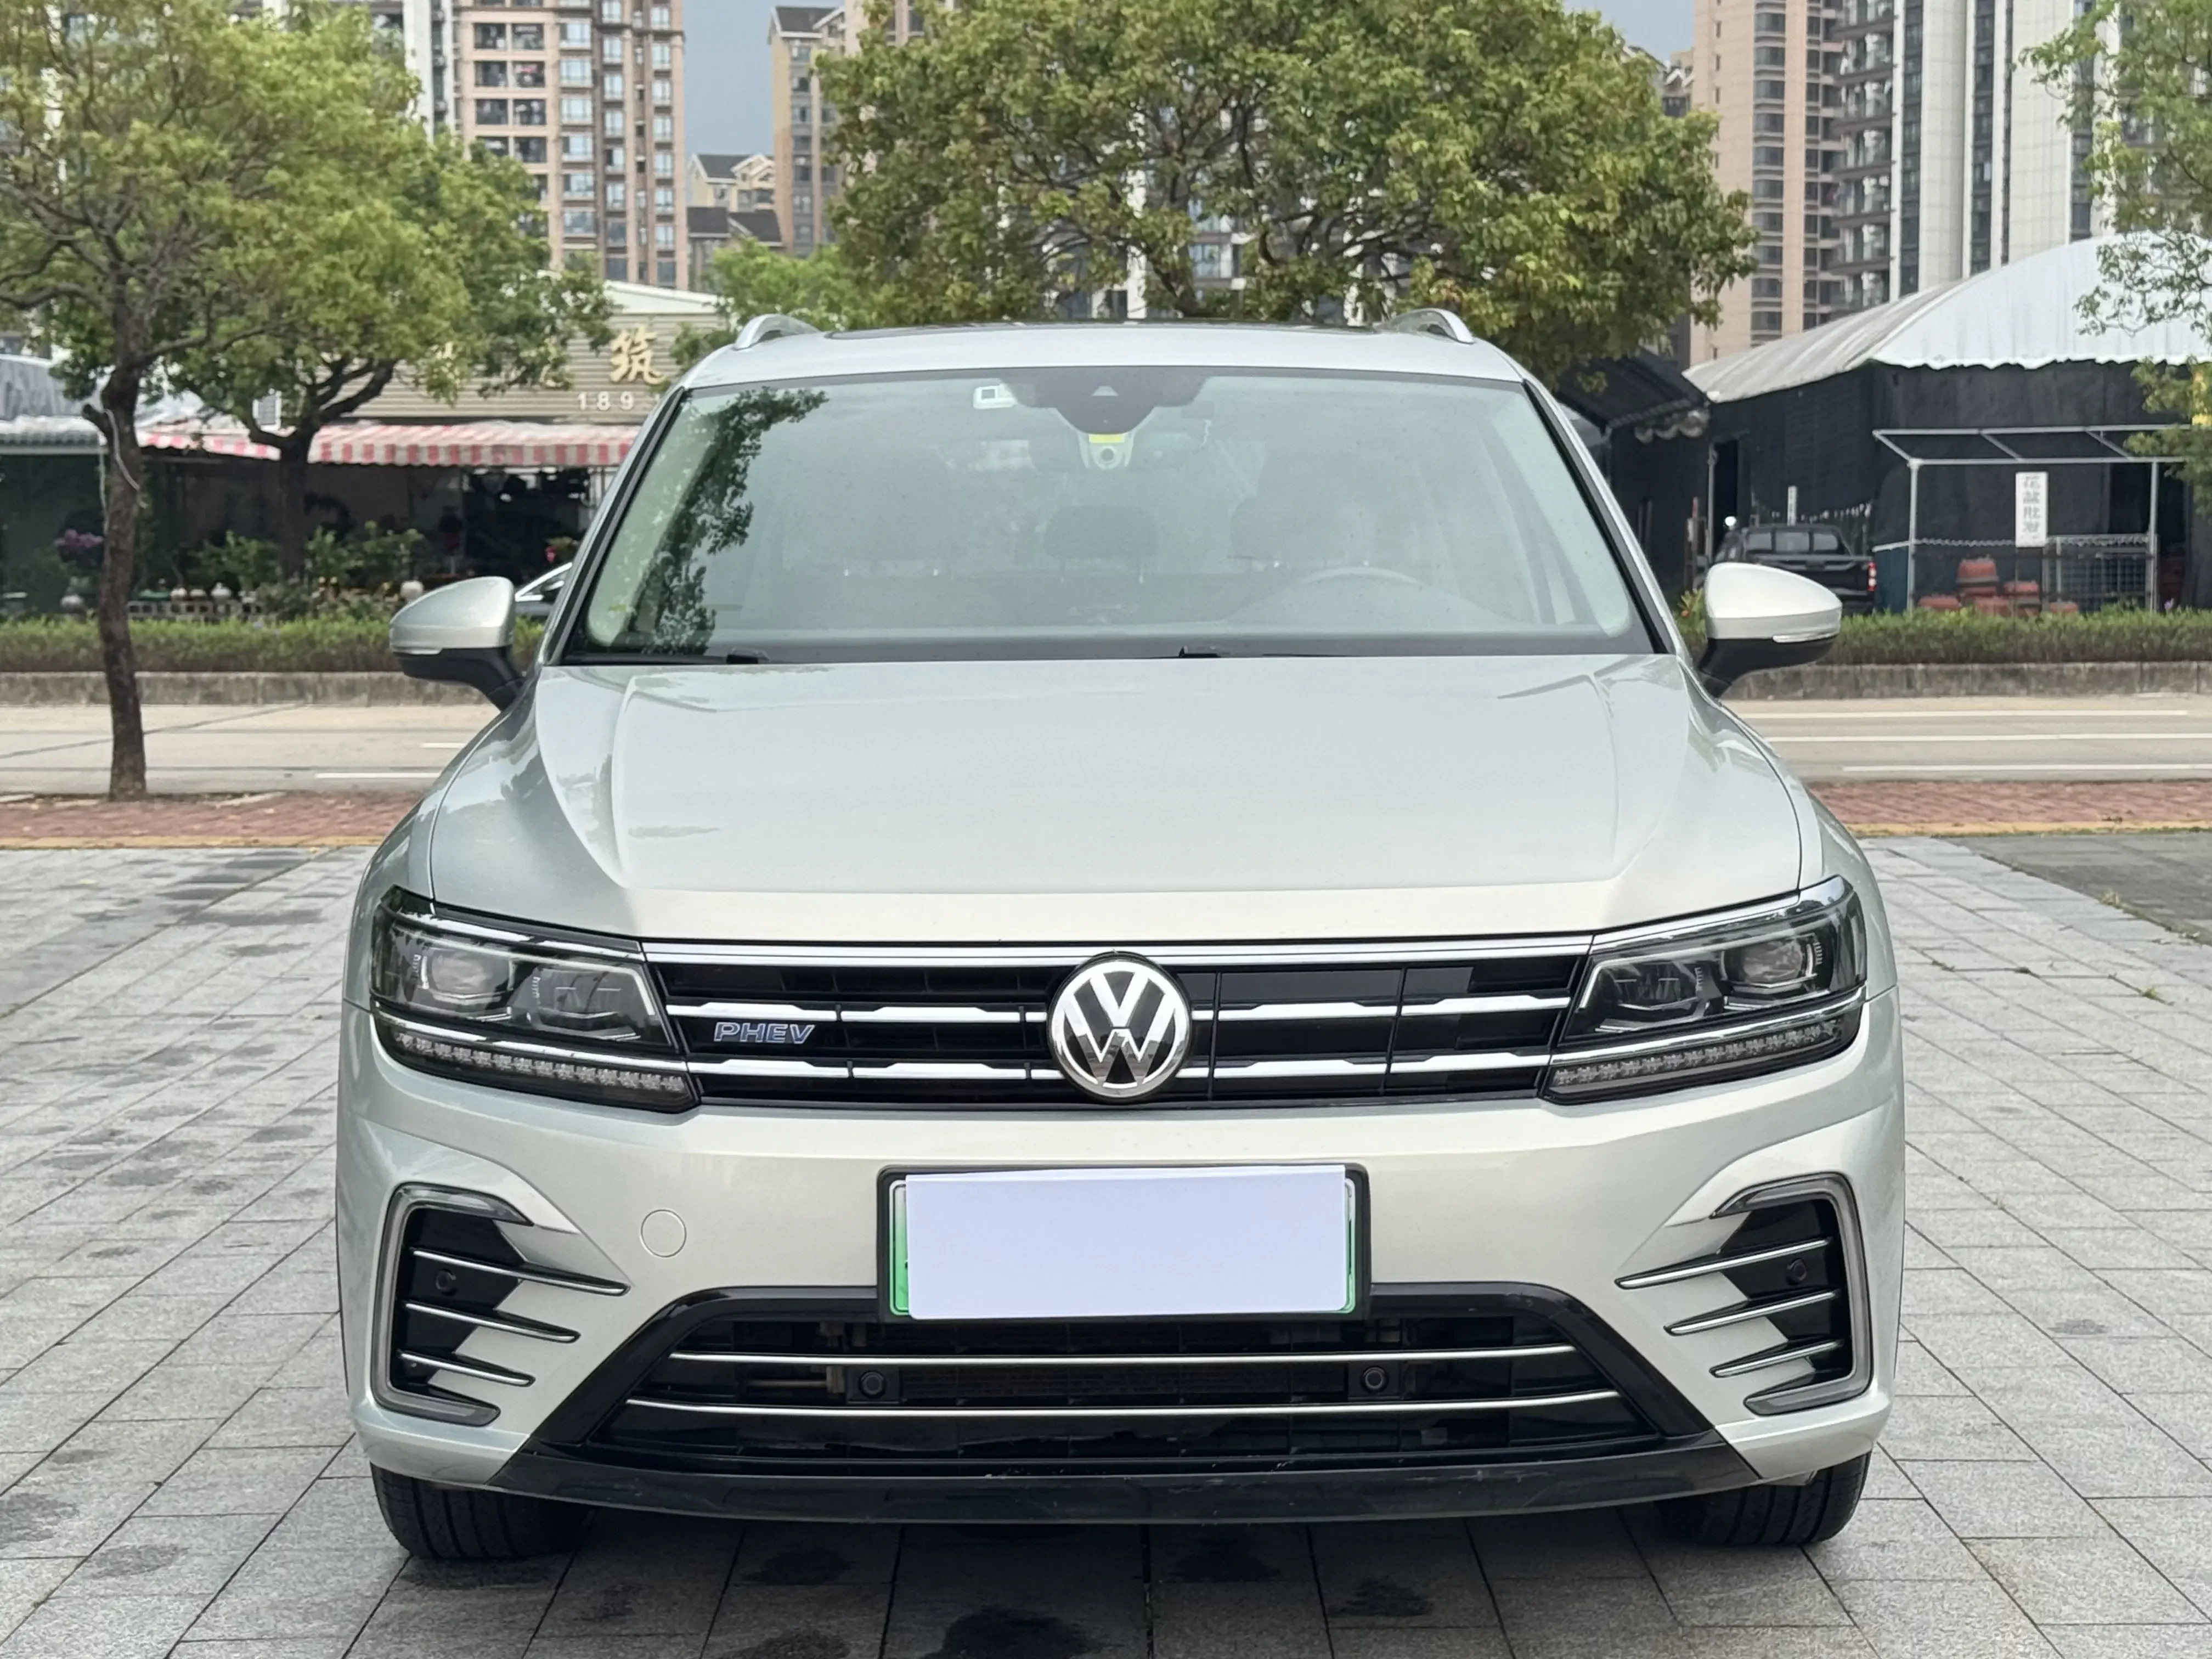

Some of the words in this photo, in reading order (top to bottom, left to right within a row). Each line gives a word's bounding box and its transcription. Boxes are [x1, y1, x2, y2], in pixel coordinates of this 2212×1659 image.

[610, 325, 666, 385] 筑
[714, 1022, 815, 1044] PHEV
[1052, 961, 1187, 1097] VW
